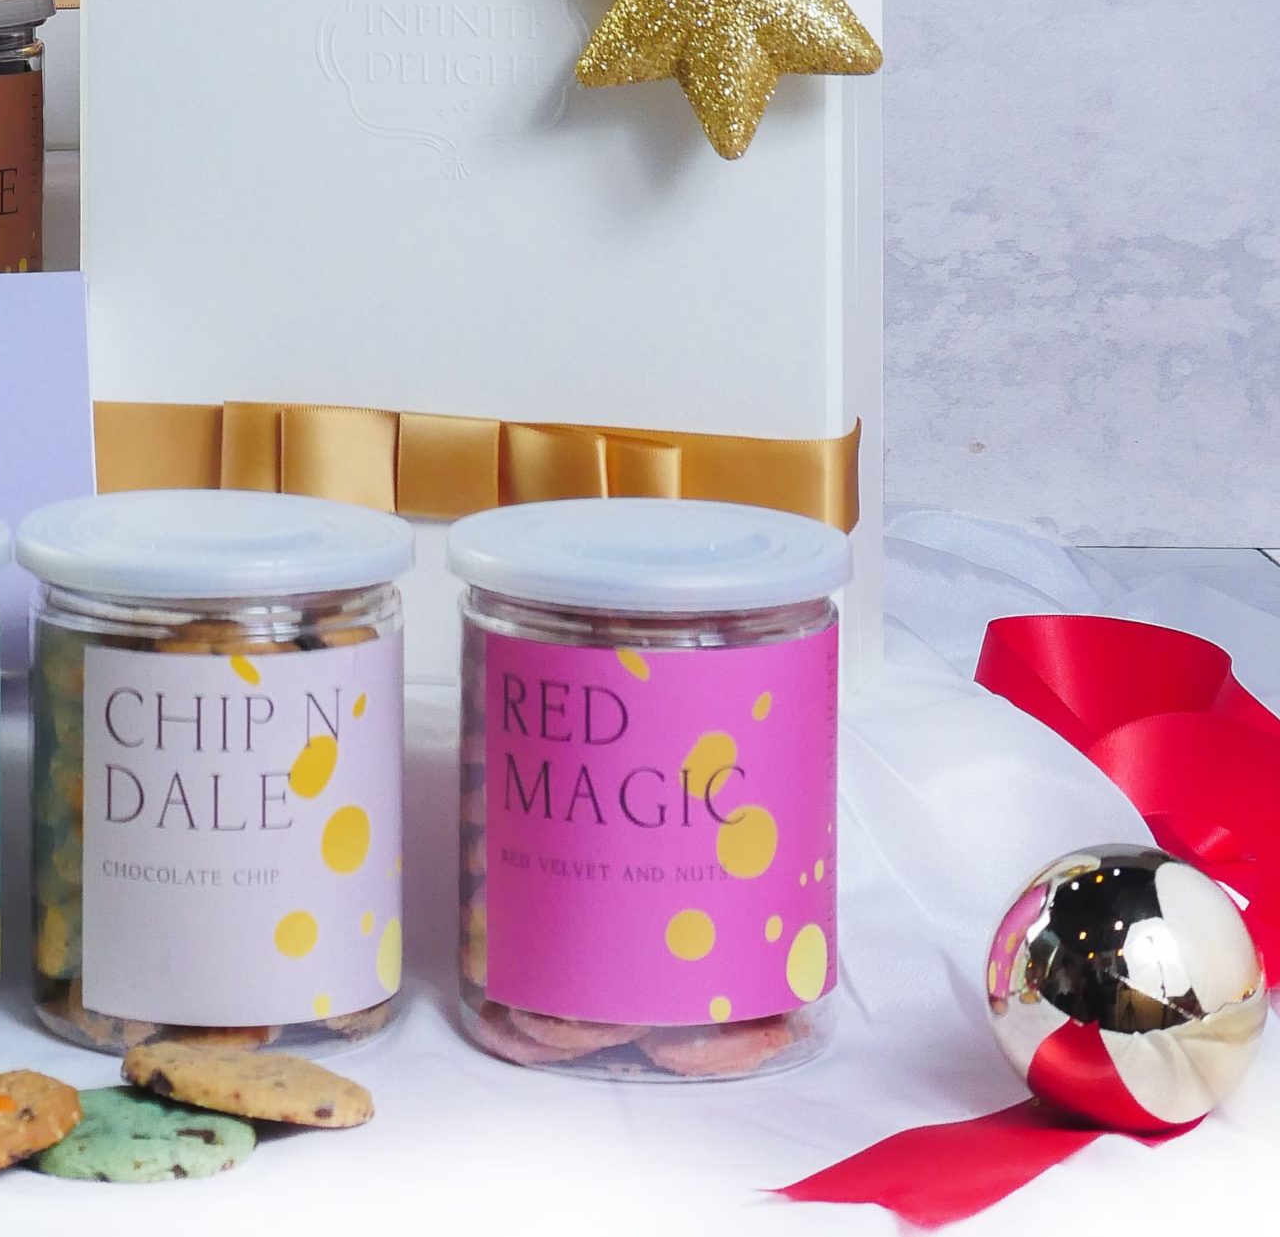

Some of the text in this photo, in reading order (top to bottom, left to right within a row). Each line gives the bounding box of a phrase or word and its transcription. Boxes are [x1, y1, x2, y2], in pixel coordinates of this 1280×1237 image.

[105, 686, 341, 753] CHIP N
[502, 673, 629, 746] RED
[105, 764, 293, 831] DALE
[504, 751, 746, 829] MAGIC
[102, 859, 280, 886] CHOCOLATE CHIP
[539, 856, 610, 882] VELVET
[623, 865, 665, 883] AND
